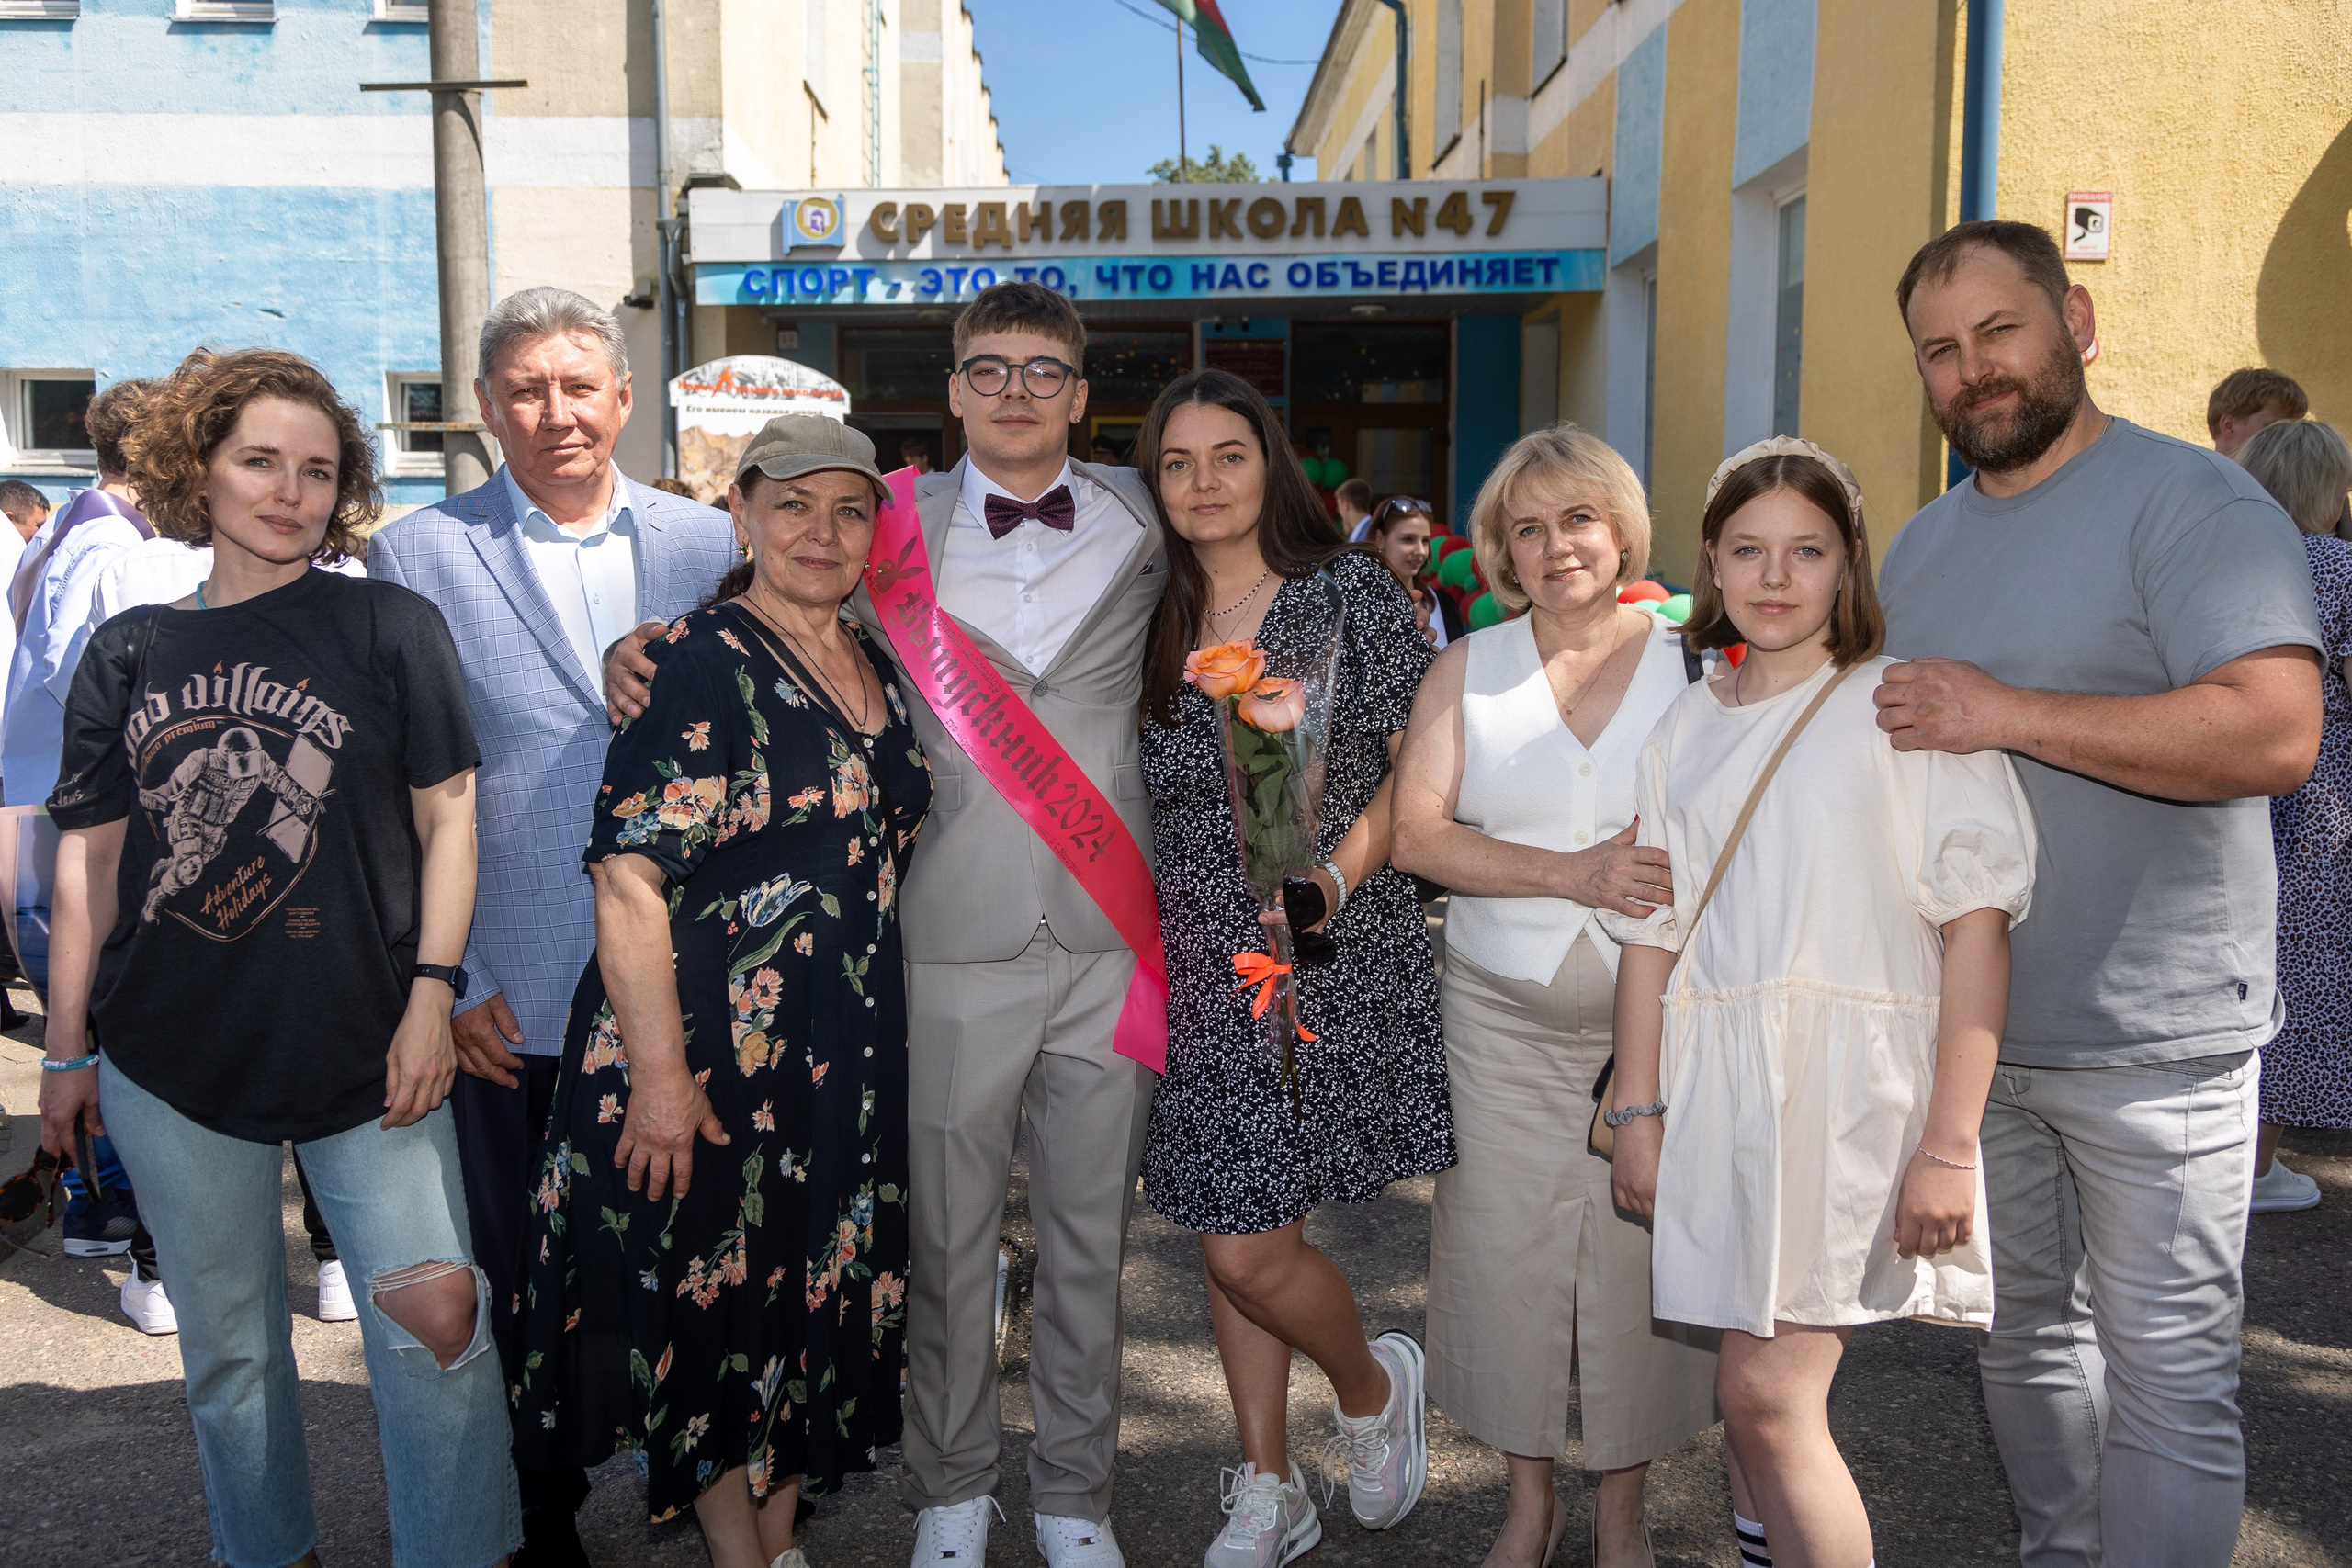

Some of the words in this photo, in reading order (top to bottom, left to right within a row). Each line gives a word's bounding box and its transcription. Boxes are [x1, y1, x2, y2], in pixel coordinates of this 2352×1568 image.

[869, 200, 1127, 249] СРЕДНЯЯ
[1151, 197, 1369, 240] ШКОЛА
[743, 267, 876, 296] СПОРТ
[920, 266, 997, 294] ЭТО
[1095, 264, 1172, 291] ЧТО
[1191, 263, 1270, 290] НАС
[1286, 257, 1559, 292] ОБЪЕДИНЯЕТ
[200, 855, 266, 914] Adventure
[216, 873, 273, 931] Holidays
